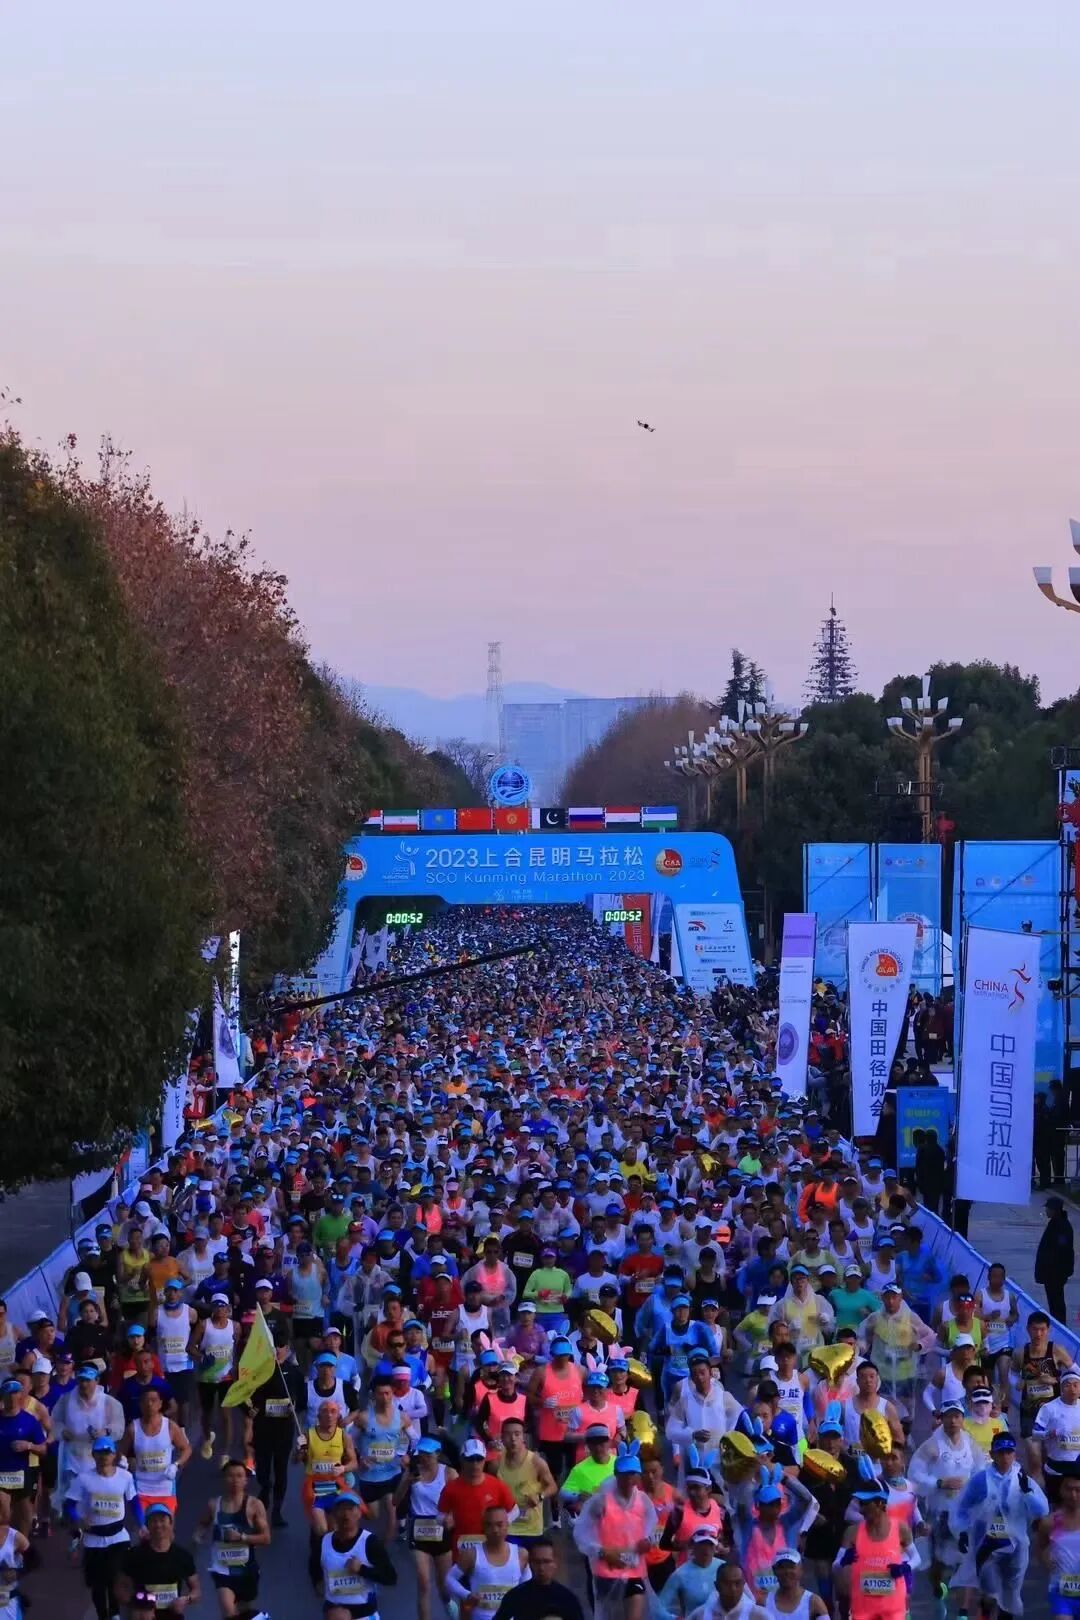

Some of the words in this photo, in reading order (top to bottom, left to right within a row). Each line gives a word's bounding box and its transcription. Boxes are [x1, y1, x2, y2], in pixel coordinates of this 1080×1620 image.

[425, 847, 645, 869] 2023上合昆明马拉松
[426, 872, 457, 884] SCO
[464, 871, 527, 885] Kunming
[533, 870, 602, 882] Marathon
[609, 870, 645, 881] 2023
[386, 912, 423, 924] 0:00:52
[605, 911, 642, 922] 0:00:52
[974, 979, 1009, 992] CHINA
[869, 999, 888, 1117] 中国田径协会
[985, 1033, 1015, 1177] 中国马拉松
[863, 1577, 892, 1588] A11052
